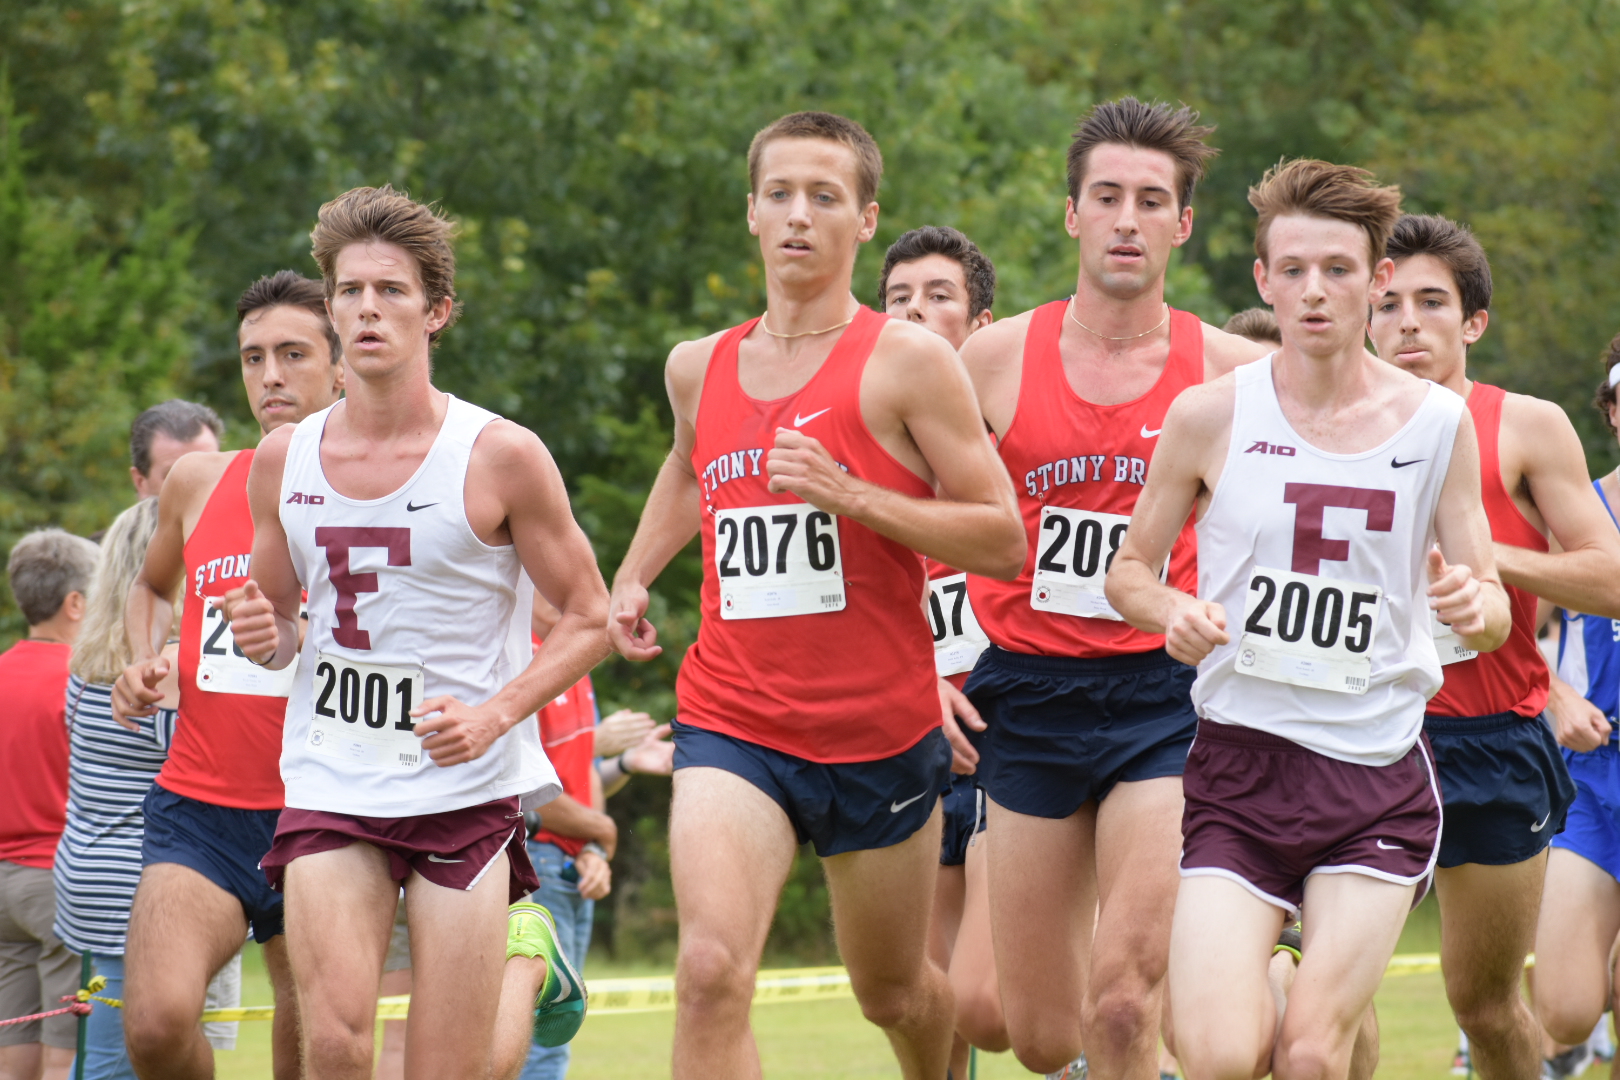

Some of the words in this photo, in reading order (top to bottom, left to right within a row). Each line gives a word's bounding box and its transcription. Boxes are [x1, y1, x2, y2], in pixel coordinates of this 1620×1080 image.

[1025, 455, 1106, 496] STONY
[1113, 455, 1147, 486] BR
[1243, 440, 1296, 457] A10
[286, 491, 325, 505] A10
[1283, 482, 1396, 576] F
[195, 553, 252, 592] STON
[718, 511, 836, 578] 2076
[1038, 514, 1131, 578] 208
[315, 526, 412, 650] F
[928, 580, 967, 642] 07
[1244, 575, 1378, 654] 2005
[315, 661, 417, 732] 2001
